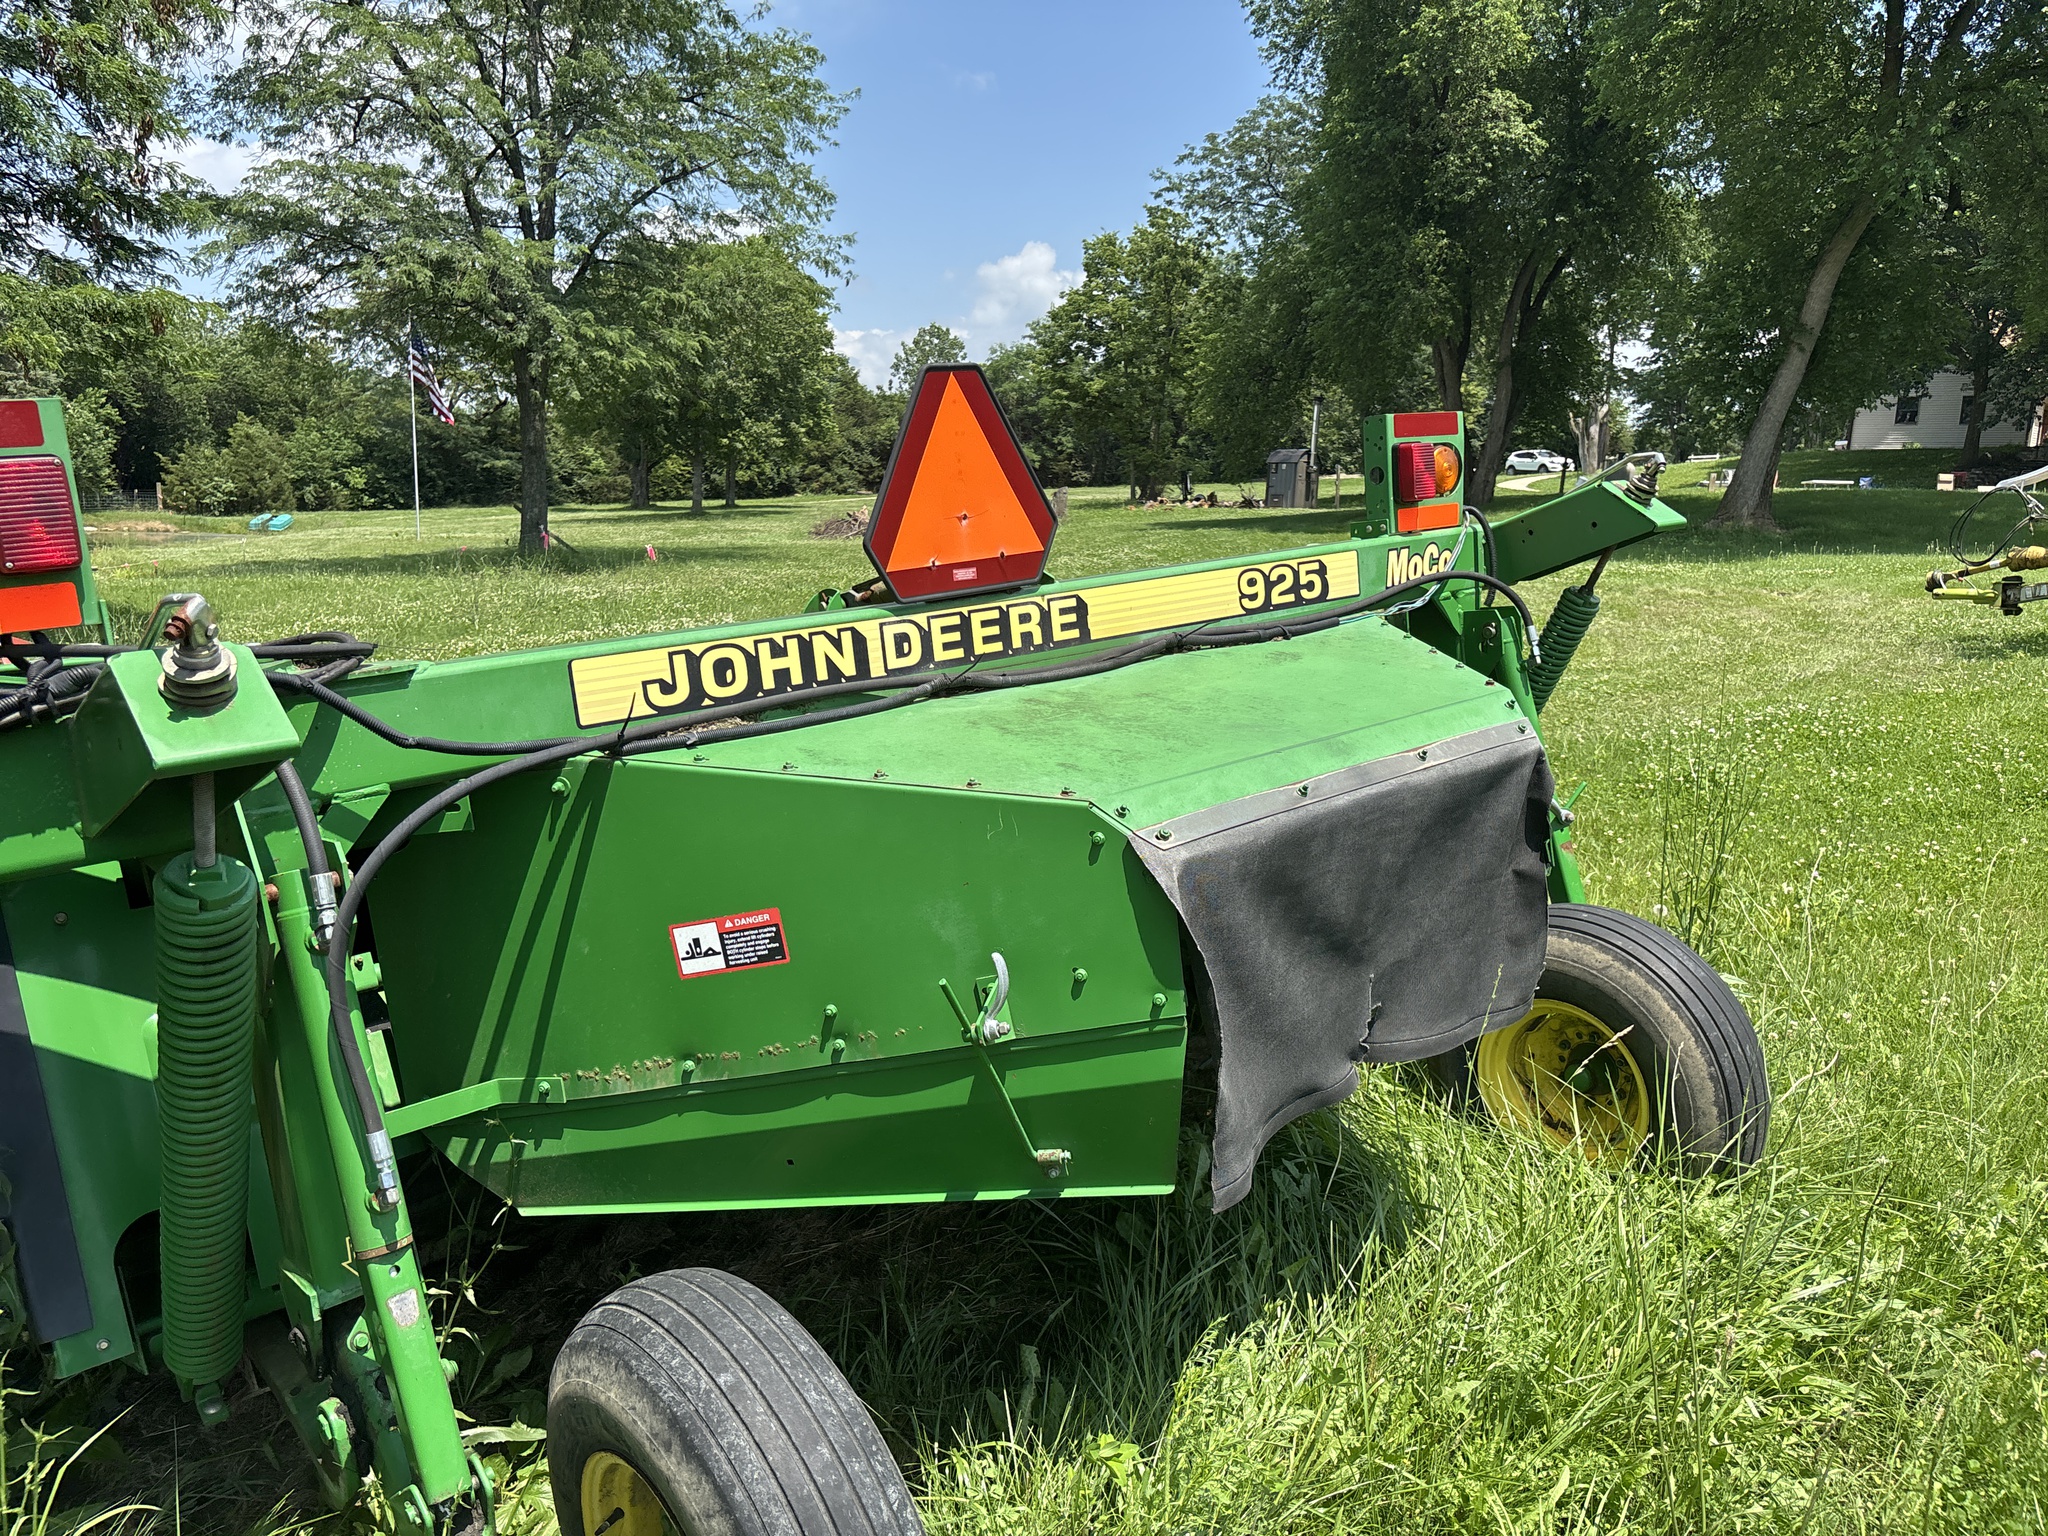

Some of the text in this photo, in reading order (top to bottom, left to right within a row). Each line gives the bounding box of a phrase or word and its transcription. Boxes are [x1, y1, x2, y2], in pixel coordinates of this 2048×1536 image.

[1238, 560, 1327, 611] 925
[643, 596, 1085, 710] JOHN DEERE
[734, 913, 770, 926] DANGER
